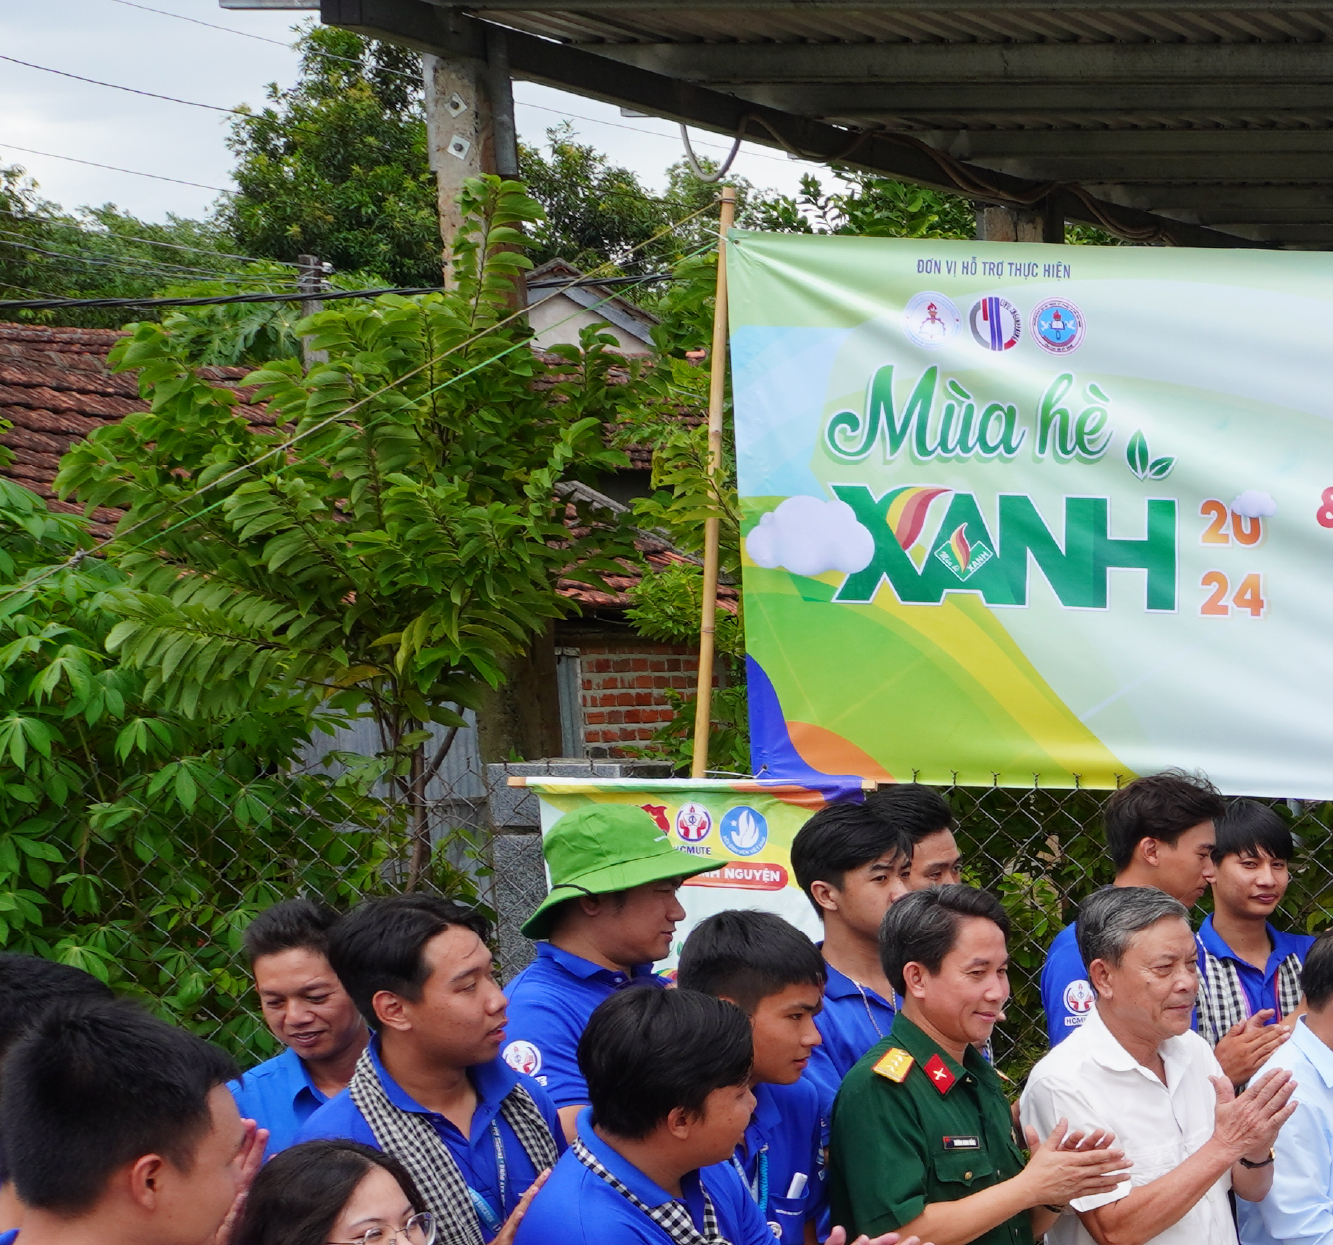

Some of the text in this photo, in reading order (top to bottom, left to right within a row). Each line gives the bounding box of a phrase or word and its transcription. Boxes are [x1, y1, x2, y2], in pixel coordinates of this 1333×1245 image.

[917, 256, 1071, 281] ĐƠN VỊ HỖ TRỢ THỰC HIỆN
[827, 365, 1113, 461] Mùa hè
[1200, 499, 1262, 547] 20
[831, 484, 1178, 613] XANH
[1200, 573, 1265, 617] 24
[725, 868, 780, 883] NGUYỆN
